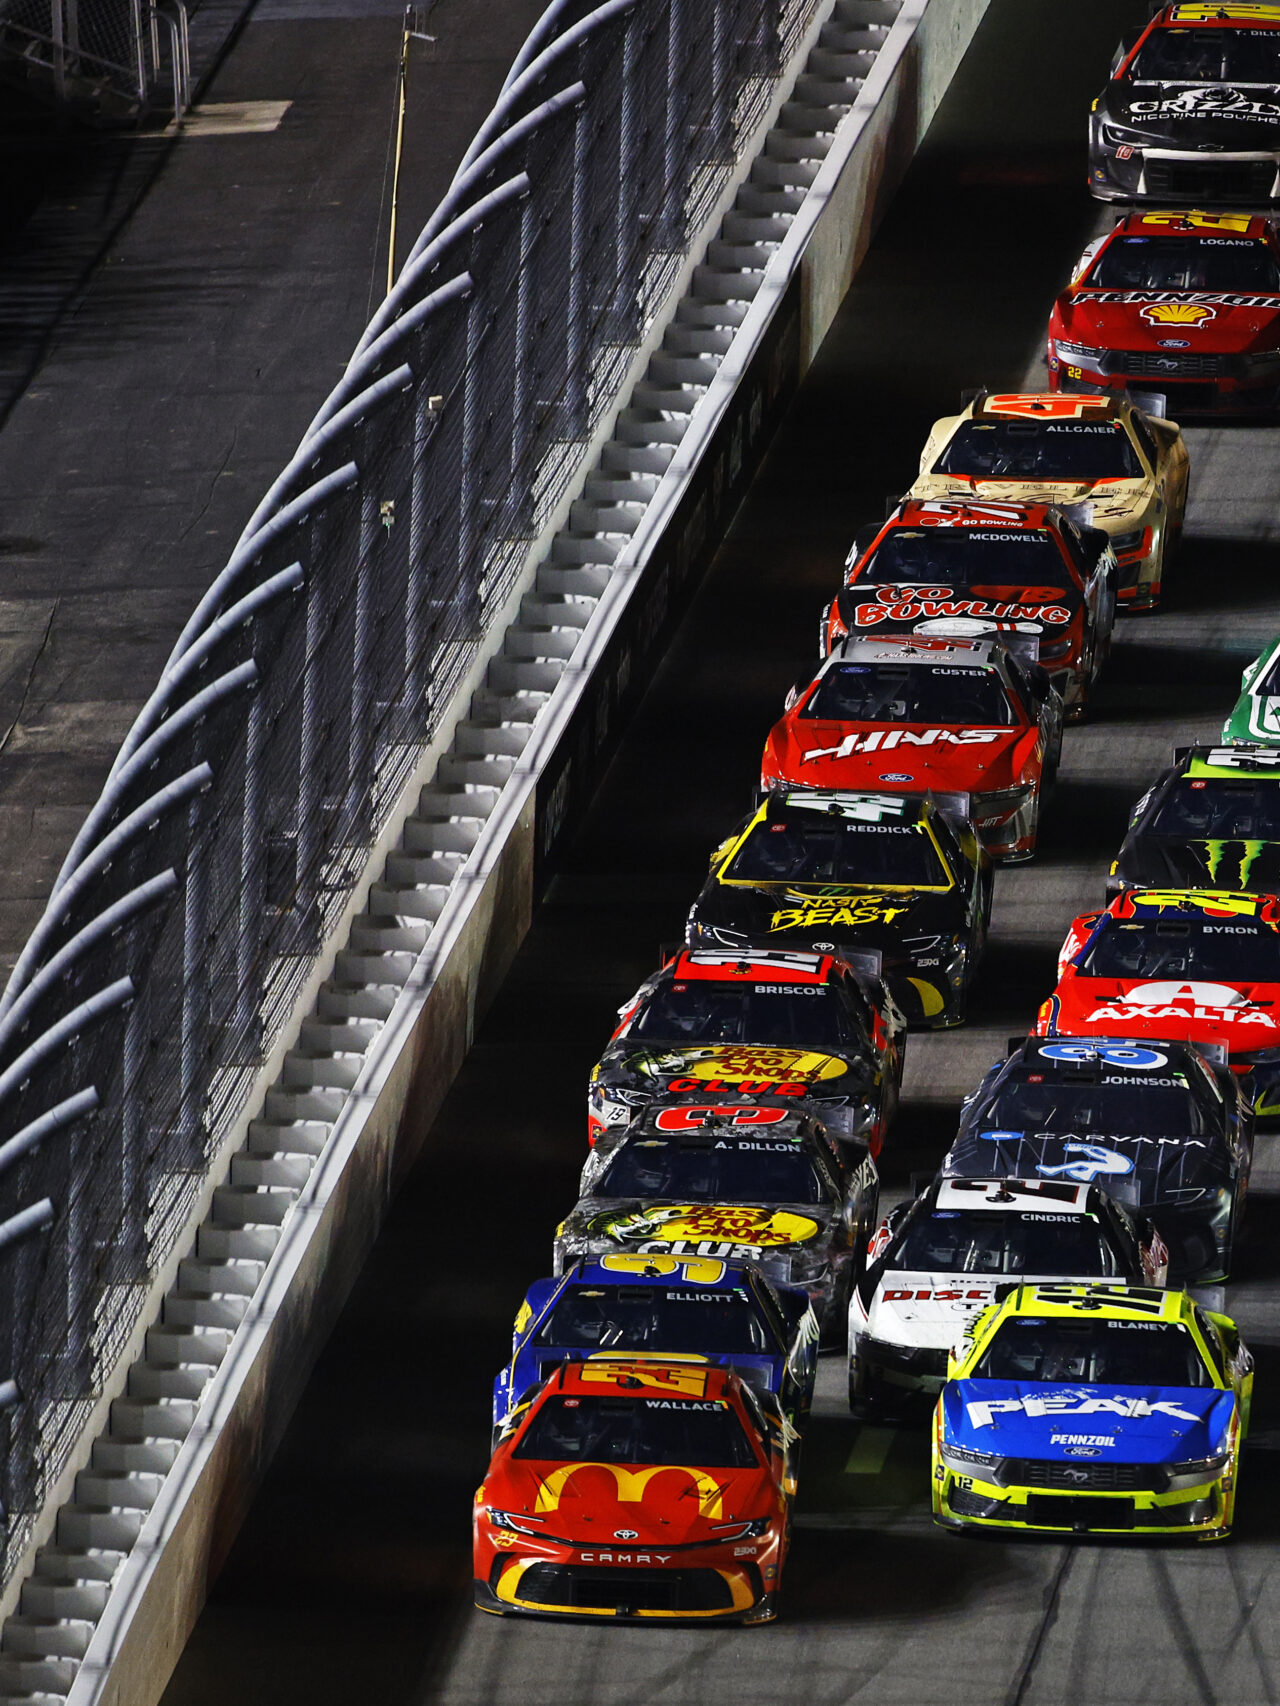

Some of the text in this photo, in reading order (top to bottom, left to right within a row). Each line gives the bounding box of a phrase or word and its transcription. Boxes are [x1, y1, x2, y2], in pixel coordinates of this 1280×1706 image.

[1235, 29, 1246, 37] T.
[1131, 112, 1207, 124] NICOTINE
[1115, 145, 1134, 160] 10
[1199, 238, 1254, 247] LOGANO
[1068, 366, 1082, 379] 22
[1046, 424, 1117, 435] ALLGAIER
[979, 519, 1023, 528] BOWLING
[968, 532, 1048, 543] MCDOWELL
[876, 587, 954, 604] GO
[854, 600, 1072, 627] BOWLING
[931, 668, 987, 677] CUSTER
[846, 825, 912, 835] REDDICK
[766, 908, 910, 933] BEAST
[1202, 926, 1258, 935] BYRON
[754, 985, 827, 996] BRISCOE
[1085, 1005, 1277, 1028] AXALTA
[719, 1046, 811, 1057] Bass
[721, 1056, 782, 1067] Pro
[714, 1064, 821, 1082] Shops
[1101, 1075, 1184, 1087] JOHNSON
[667, 1079, 810, 1097] CLUB
[606, 1106, 627, 1121] 19
[715, 1141, 800, 1152] A. DILLON
[1034, 1133, 1207, 1148] CARVANA
[686, 1206, 768, 1217] Bass
[688, 1217, 751, 1227] Pro
[1021, 1213, 1081, 1223] CINDRIC
[683, 1225, 791, 1243] Shops
[637, 1241, 763, 1260] CLUB
[667, 1292, 733, 1302] ELLIOTT
[882, 1290, 992, 1303] DISC
[1107, 1321, 1168, 1331] BLANEY
[646, 1400, 723, 1412] WALLACE
[966, 1396, 1203, 1429] PEAK
[1050, 1434, 1116, 1447] PENNZOIL
[957, 1476, 974, 1490] 12
[580, 1552, 672, 1564] CAMRY
